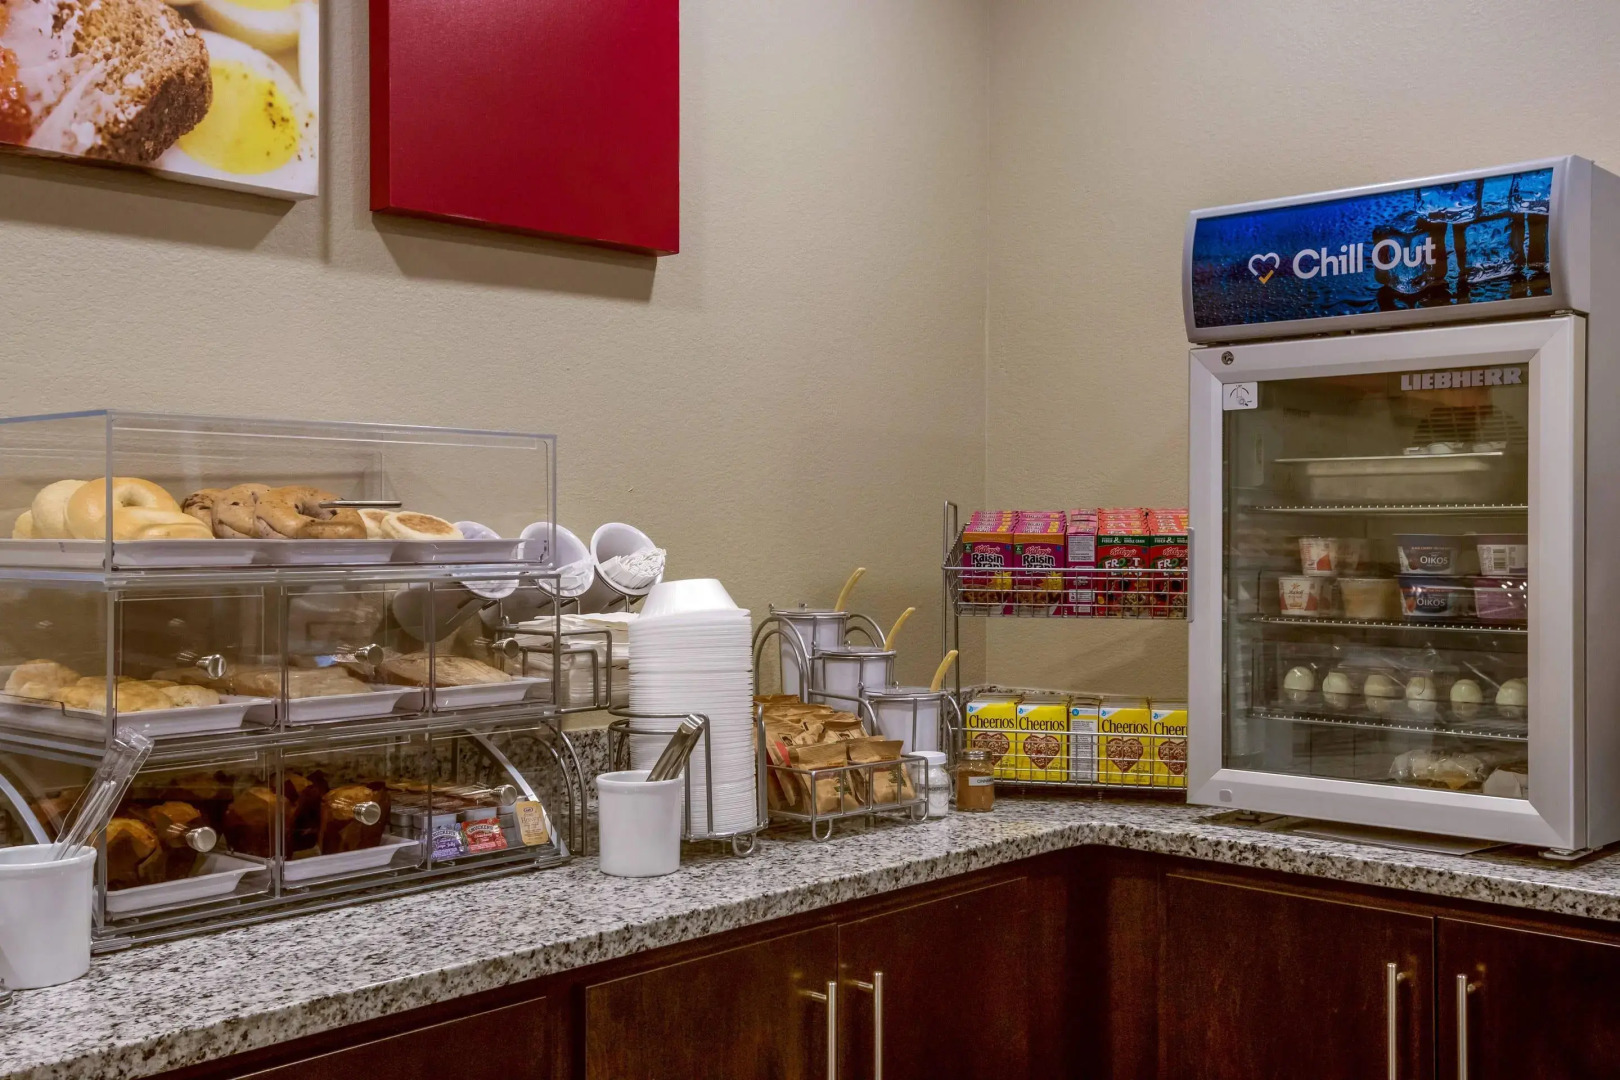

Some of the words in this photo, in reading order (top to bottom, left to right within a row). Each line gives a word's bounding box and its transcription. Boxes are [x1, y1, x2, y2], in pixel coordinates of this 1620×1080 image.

[1292, 242, 1363, 279] Chill
[1371, 237, 1436, 270] Out
[1401, 368, 1521, 391] LIEBHERR
[971, 553, 1004, 565] Raisin
[1022, 554, 1055, 566] Raisin
[1420, 555, 1448, 565] OIKOS
[1416, 597, 1445, 607] OIKOS
[968, 714, 1015, 729] Cheerios
[1018, 717, 1065, 731] Cheerios
[1101, 719, 1149, 734] Cheerios
